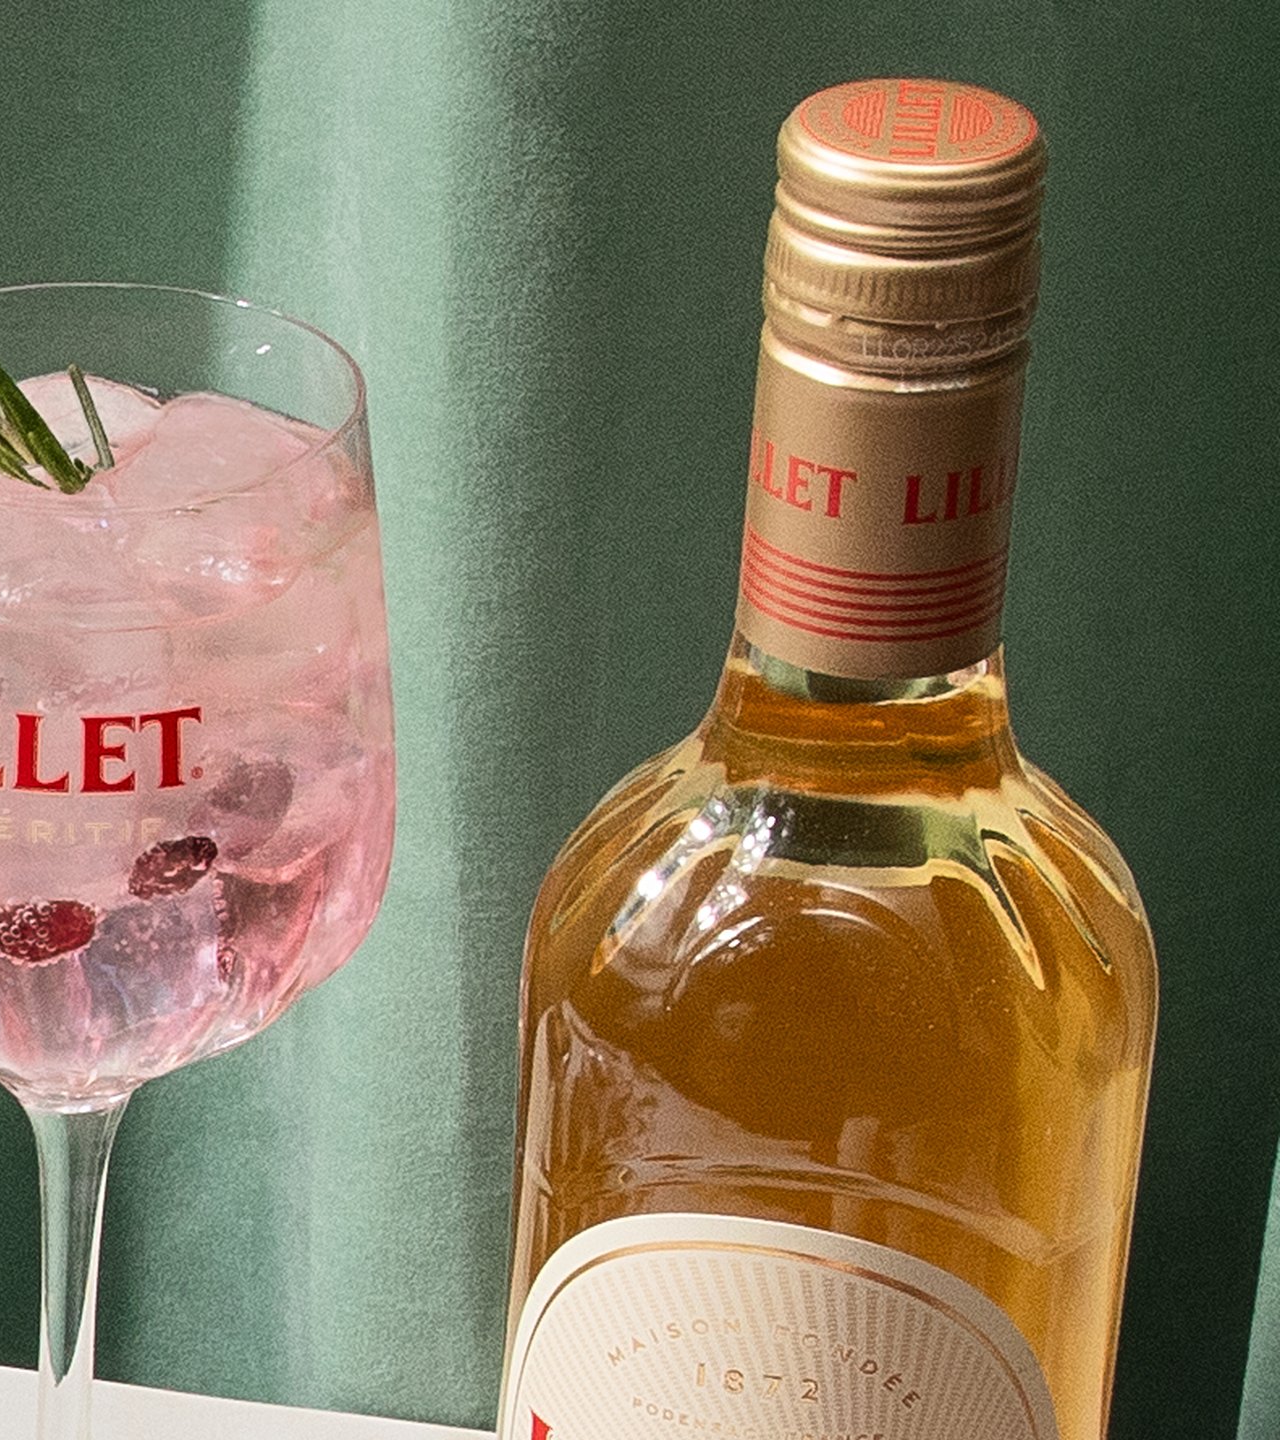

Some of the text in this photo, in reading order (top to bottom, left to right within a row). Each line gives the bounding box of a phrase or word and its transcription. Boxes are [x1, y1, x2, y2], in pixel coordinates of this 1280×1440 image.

[888, 80, 944, 158] LILLET
[607, 1318, 742, 1368] MAISON
[695, 1362, 820, 1402] 1872
